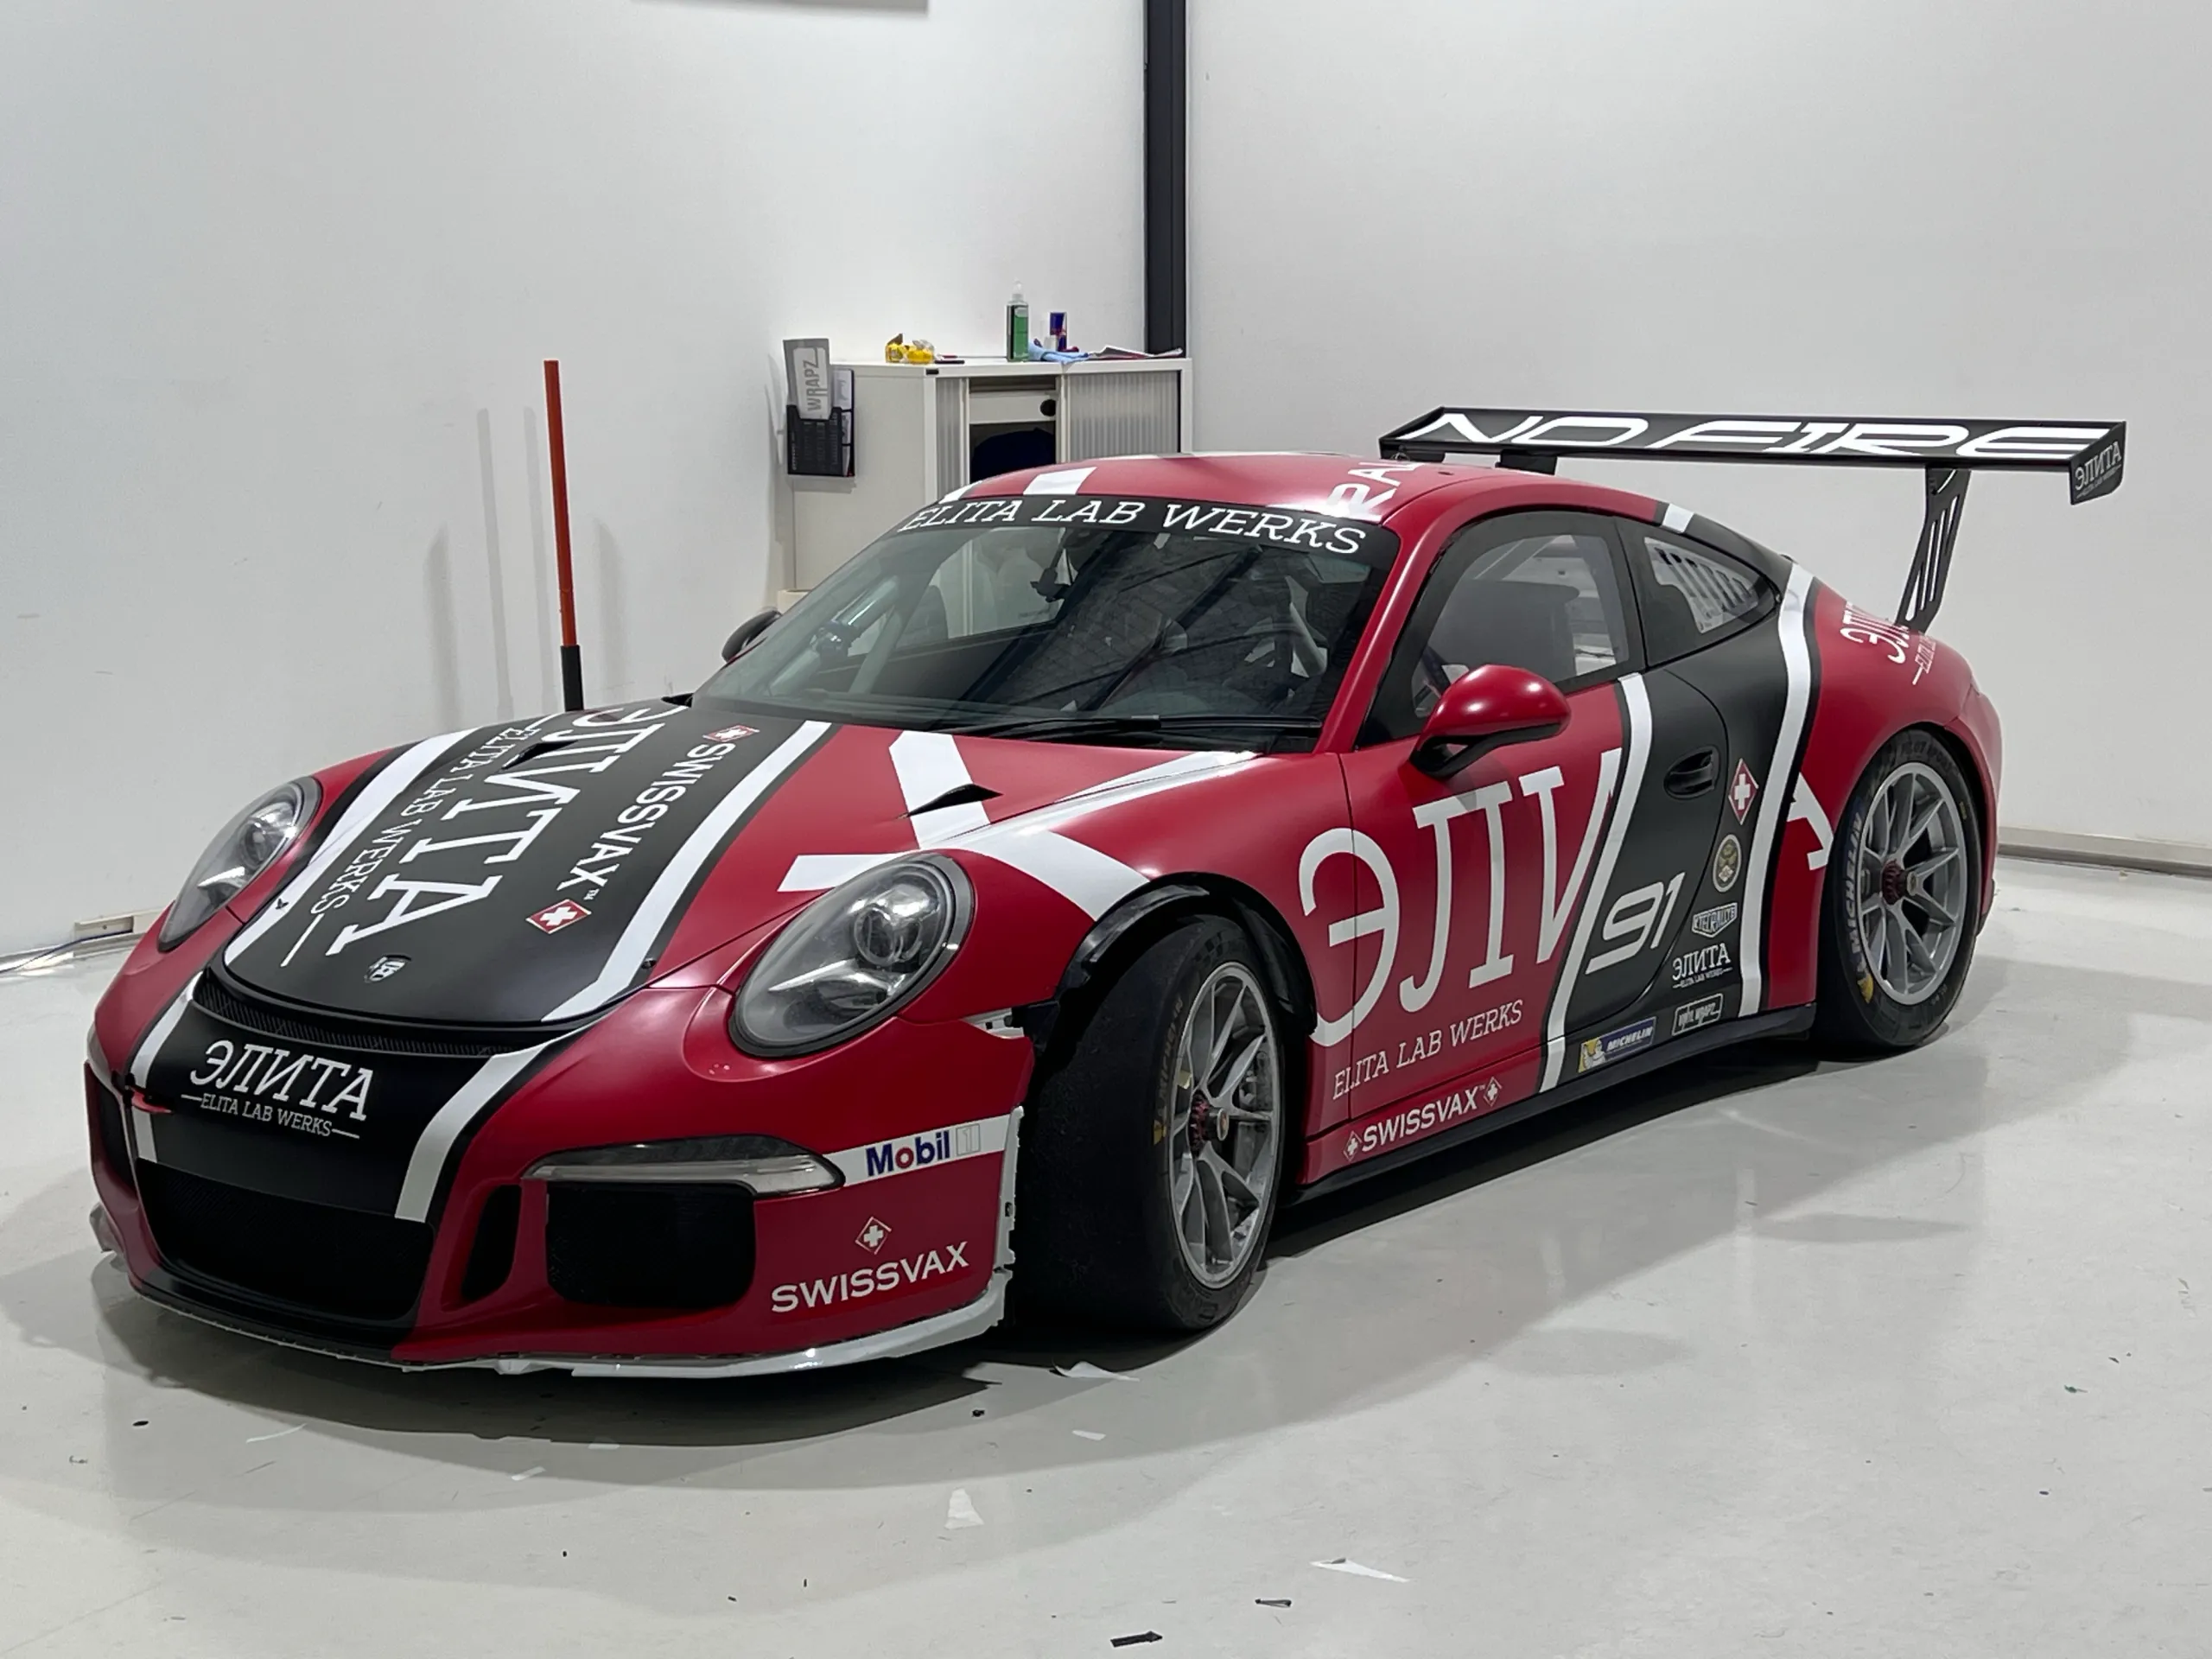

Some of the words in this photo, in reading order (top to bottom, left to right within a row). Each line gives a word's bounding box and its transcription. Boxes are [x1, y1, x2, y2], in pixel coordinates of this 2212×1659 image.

[802, 359, 827, 412] WRAPZ
[1395, 412, 1649, 448] NO
[1644, 419, 2110, 459] FIRE
[896, 499, 1019, 532] ELITA
[1032, 500, 1147, 525] LAB
[1163, 504, 1367, 554] WERKS
[450, 727, 543, 774] ELITA
[400, 772, 474, 817] LAB
[309, 817, 423, 914] WERKS
[1586, 871, 1685, 975] 91
[1672, 943, 1732, 981] ЭЛИТА
[1332, 1051, 1389, 1100] ELITA
[1396, 1029, 1442, 1068] LAB
[1450, 999, 1523, 1047] WERKS
[1606, 1026, 1654, 1052] MICHELIN
[189, 1039, 374, 1122] ЭЛИТА
[200, 1093, 238, 1116] ELITA
[242, 1101, 273, 1122] LAB
[277, 1108, 333, 1137] WERKS
[866, 1130, 950, 1177] Mobil
[772, 1241, 969, 1313] SWISSVAX
